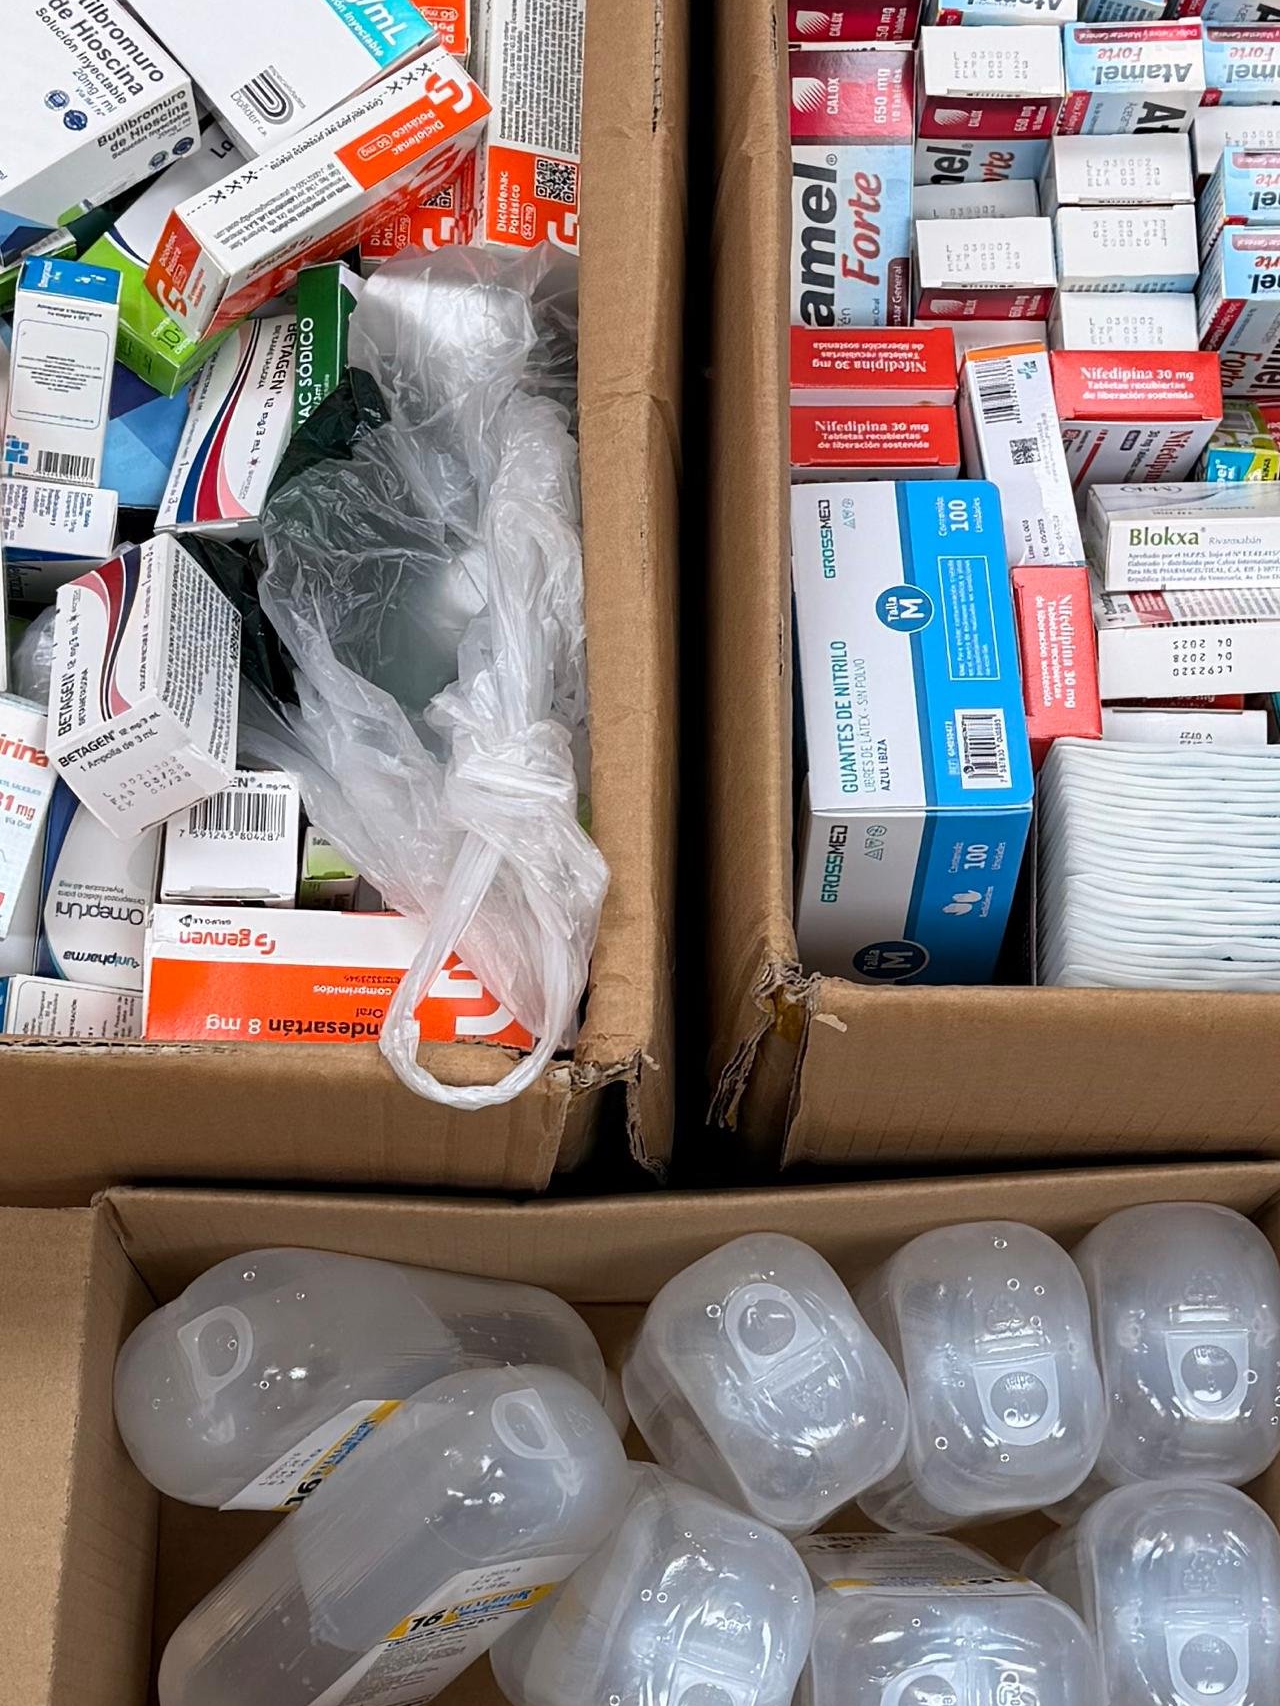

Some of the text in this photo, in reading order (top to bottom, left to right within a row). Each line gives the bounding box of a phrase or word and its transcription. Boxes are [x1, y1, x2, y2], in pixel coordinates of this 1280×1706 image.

[70, 19, 144, 97] Hioscina
[1096, 63, 1193, 85] Atamel
[826, 77, 841, 115] CALOX
[873, 93, 886, 125] 650
[97, 90, 187, 148] Butilbromuro
[495, 171, 509, 234] Diclofenac
[792, 153, 838, 326] amel®
[842, 171, 882, 286] Forte
[298, 317, 315, 387] SÓDICO
[812, 359, 927, 373] Nifedipina 30 mg
[1080, 367, 1195, 381] Nifedipina 30 mg
[815, 420, 929, 433] Nifedipina 30 mg
[949, 499, 968, 531] 100
[818, 499, 836, 579] GROSSMED
[1129, 529, 1200, 547] Blokxa
[888, 596, 899, 622] Talla
[899, 598, 925, 620] M
[1058, 594, 1075, 689] Nifedipina 30
[58, 672, 75, 737] BETAGEN
[830, 640, 858, 794] GUANTES DE NITRILO
[877, 739, 891, 792] AZUL IBIZA
[16, 803, 36, 820] mg
[821, 825, 848, 903] GROSSMED
[964, 844, 989, 870] 100
[55, 900, 144, 926] OmeprUni
[179, 929, 252, 946] genven
[63, 950, 134, 968] unipharma
[312, 985, 392, 996] comprimidos
[206, 1015, 261, 1033] 8 mg
